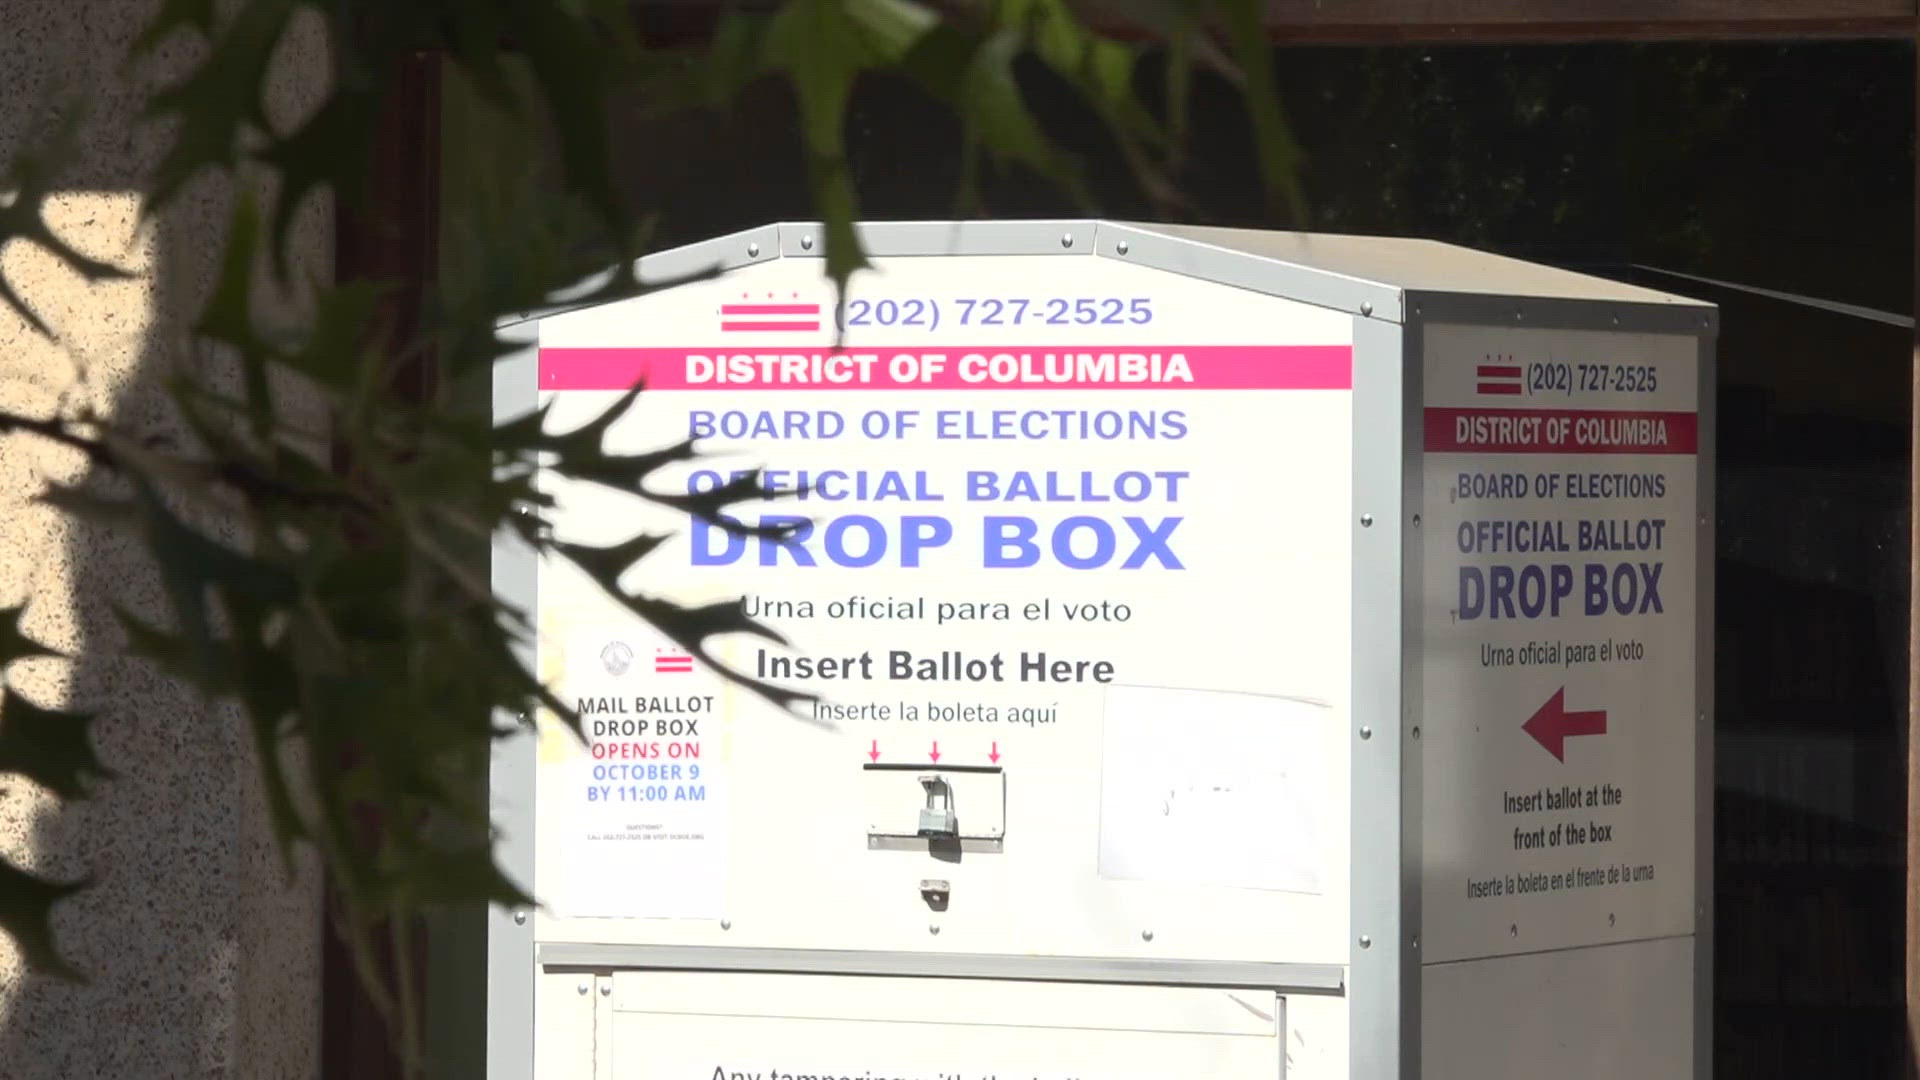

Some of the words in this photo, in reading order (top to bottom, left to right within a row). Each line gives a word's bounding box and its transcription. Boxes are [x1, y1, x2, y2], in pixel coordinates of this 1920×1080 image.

[834, 297, 940, 332] (202)
[955, 298, 1153, 325] 727-2525
[685, 354, 877, 383] DISTRICT
[889, 354, 946, 383] OF
[957, 354, 1194, 384] COLUMBIA
[1527, 362, 1573, 396] (202)
[1577, 363, 1657, 393] 727-2525
[688, 410, 845, 440] BOARD
[861, 410, 920, 440] OF
[937, 410, 1188, 440] ELECTIONS
[1456, 416, 1542, 444] DISTRICT
[1546, 417, 1571, 444] OF
[1575, 418, 1668, 446] COLUMBIA
[967, 471, 1189, 502] BALLOT
[1457, 473, 1528, 499] BOARD
[1535, 474, 1561, 499] OF
[1566, 473, 1666, 499] ELECTIONS
[690, 514, 953, 569] DROP
[983, 515, 1185, 570] BOX
[1457, 520, 1570, 553] OFFICIAL
[1578, 519, 1666, 552] BALLOT
[1458, 564, 1574, 621] DROP
[1584, 562, 1664, 616] BOX
[742, 595, 814, 619] Urna
[827, 595, 924, 620] oficial
[937, 602, 1010, 626] para
[1023, 598, 1050, 621] el
[1063, 600, 1132, 622] voto
[757, 648, 873, 680] Insert
[889, 650, 1004, 682] Ballot
[1020, 652, 1115, 684] Here
[1481, 643, 1515, 668] Urna
[1518, 640, 1561, 666] oficial
[1565, 644, 1597, 669] para
[1599, 638, 1612, 662] el
[1615, 639, 1644, 662] voto
[577, 696, 628, 714] MAIL
[635, 695, 715, 714] BALLOT
[813, 700, 891, 721] Inserte
[899, 701, 919, 722] la
[927, 701, 999, 723] boleta
[1007, 703, 1057, 728] aquí
[593, 719, 649, 737] DROP
[656, 719, 698, 737] BOX
[591, 742, 660, 760] OPENS
[667, 742, 700, 759] ON
[593, 764, 682, 781] OCTOBER
[689, 764, 700, 781] 9
[587, 786, 611, 802] BY
[617, 785, 668, 802] 11:00
[674, 785, 705, 802] AM
[1503, 791, 1543, 815] Insert
[1546, 787, 1583, 811] ballot
[1585, 786, 1599, 808] at
[1601, 783, 1622, 806] the
[1513, 826, 1546, 850] front
[1548, 824, 1562, 847] of
[1565, 823, 1587, 846] the
[1589, 821, 1612, 844] box
[1467, 876, 1503, 899] Inserte
[1505, 876, 1515, 895] la
[1517, 872, 1549, 894] boleta
[1550, 875, 1564, 892] en
[1565, 869, 1575, 889] el
[1576, 867, 1606, 888] frente
[1607, 865, 1620, 885] de
[1621, 863, 1631, 883] la
[1632, 864, 1654, 883] urna
